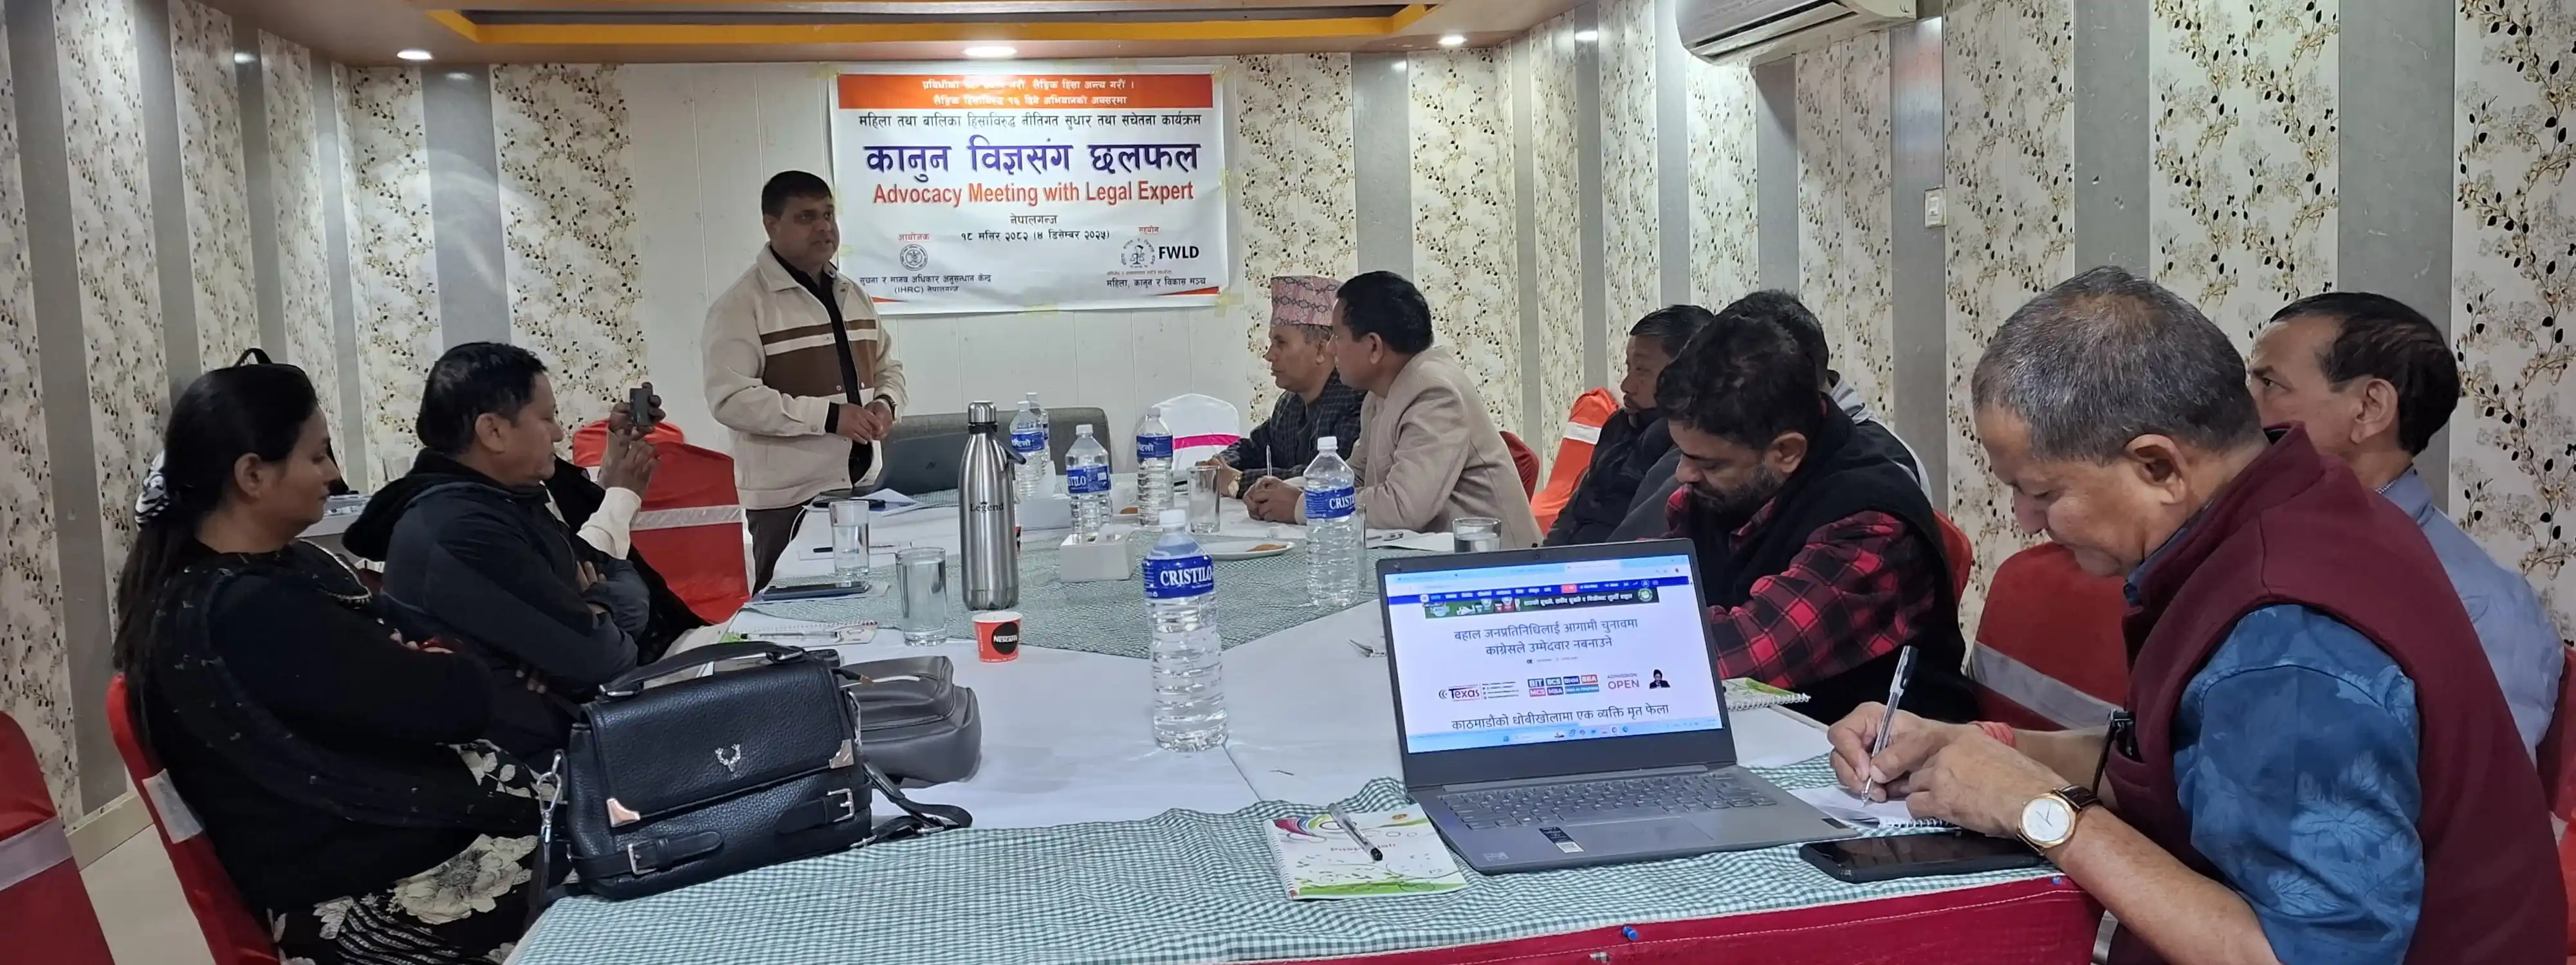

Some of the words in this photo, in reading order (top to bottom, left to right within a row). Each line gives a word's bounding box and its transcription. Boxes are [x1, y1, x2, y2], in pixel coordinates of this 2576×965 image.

[859, 111, 892, 129] महिला
[897, 115, 917, 127] तथा
[923, 111, 962, 128] बालिका
[1022, 111, 1060, 127] नीतिगत
[1065, 115, 1093, 130] सुधार
[1097, 115, 1117, 127] तथा
[1121, 112, 1157, 128] सचेतना
[1161, 111, 1202, 127] कार्यक्रम
[863, 145, 953, 183] कानुन
[966, 134, 1074, 176] विज्ञसंग
[1087, 143, 1202, 174] छलफल
[873, 183, 962, 208] Advocacy
[968, 183, 1039, 207] Meeting
[1044, 182, 1080, 201] with
[1085, 181, 1132, 205] Legal
[1137, 180, 1194, 205] Expert
[1010, 213, 1058, 226] नेपालगन्ज
[1005, 232, 1029, 242] २०८२
[1159, 246, 1199, 259] FWLD
[894, 286, 924, 295] (IHRC)
[970, 502, 1004, 513] Legend
[1160, 565, 1212, 586] CRISTILO
[1484, 621, 1560, 638] जनप्रतिनिधिलाई
[1564, 619, 1598, 634] आगामी
[1601, 618, 1638, 634] चुनावमा
[1529, 639, 1570, 653] उम्मेदवार
[1608, 679, 1639, 690] OPEN
[1449, 687, 1480, 699] Texas
[1576, 710, 1594, 721] एक
[1597, 706, 1624, 719] व्यक्ति
[1645, 703, 1670, 715] फेला
